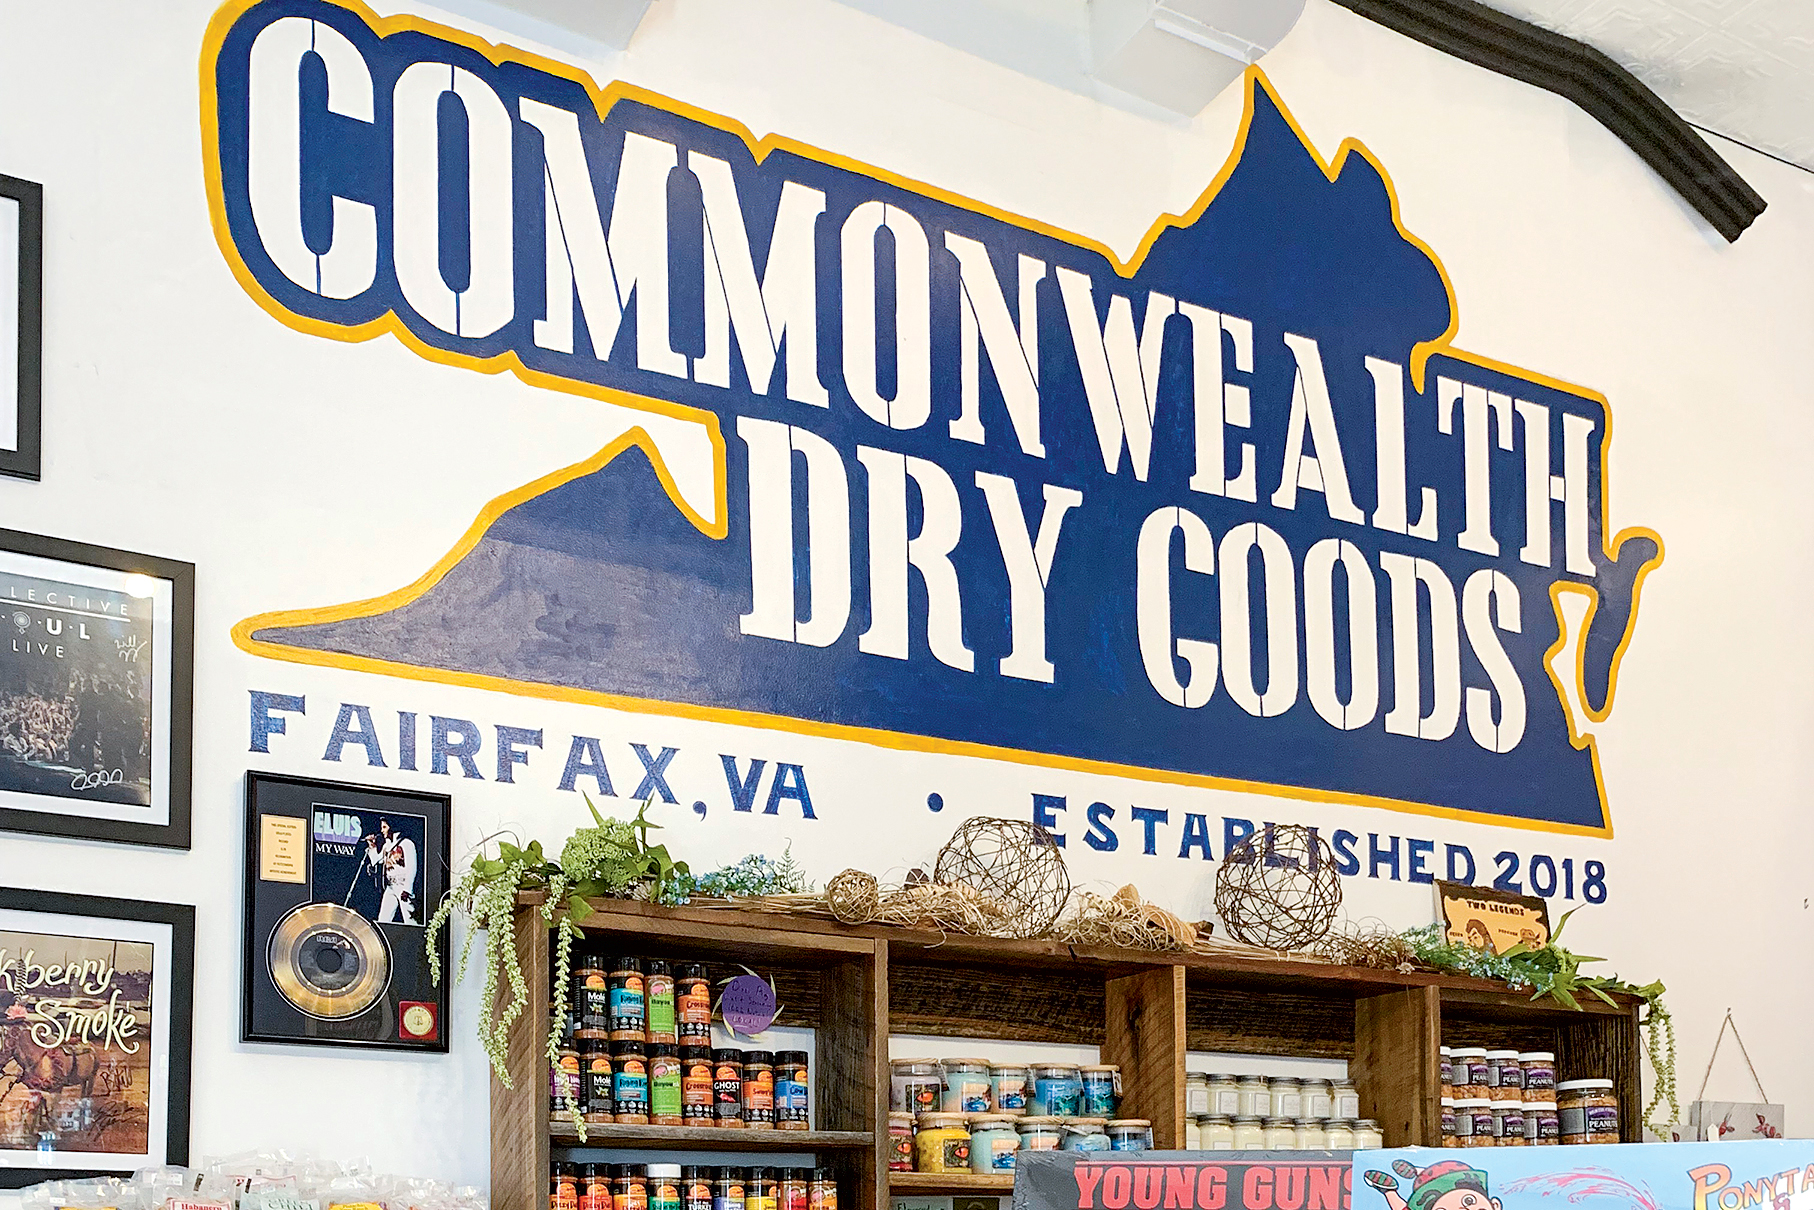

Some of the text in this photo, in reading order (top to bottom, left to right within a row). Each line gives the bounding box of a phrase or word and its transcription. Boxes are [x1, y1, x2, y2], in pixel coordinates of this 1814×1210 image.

[247, 14, 1597, 578] COMMONWEALTH
[736, 414, 1528, 755] DRY GOODS
[12, 639, 64, 658] LIVE
[717, 753, 819, 820] VA
[315, 842, 357, 856] MY WAY
[1031, 792, 1608, 905] ESTABLISHED 2018
[1467, 900, 1525, 916] TWO LEGENDS
[31, 989, 140, 1055] Smoke
[714, 1081, 740, 1090] GHOST
[1073, 1166, 1228, 1210] YOUNG
[181, 1203, 223, 1210] Habanero
[687, 1203, 712, 1210] TURKEY
